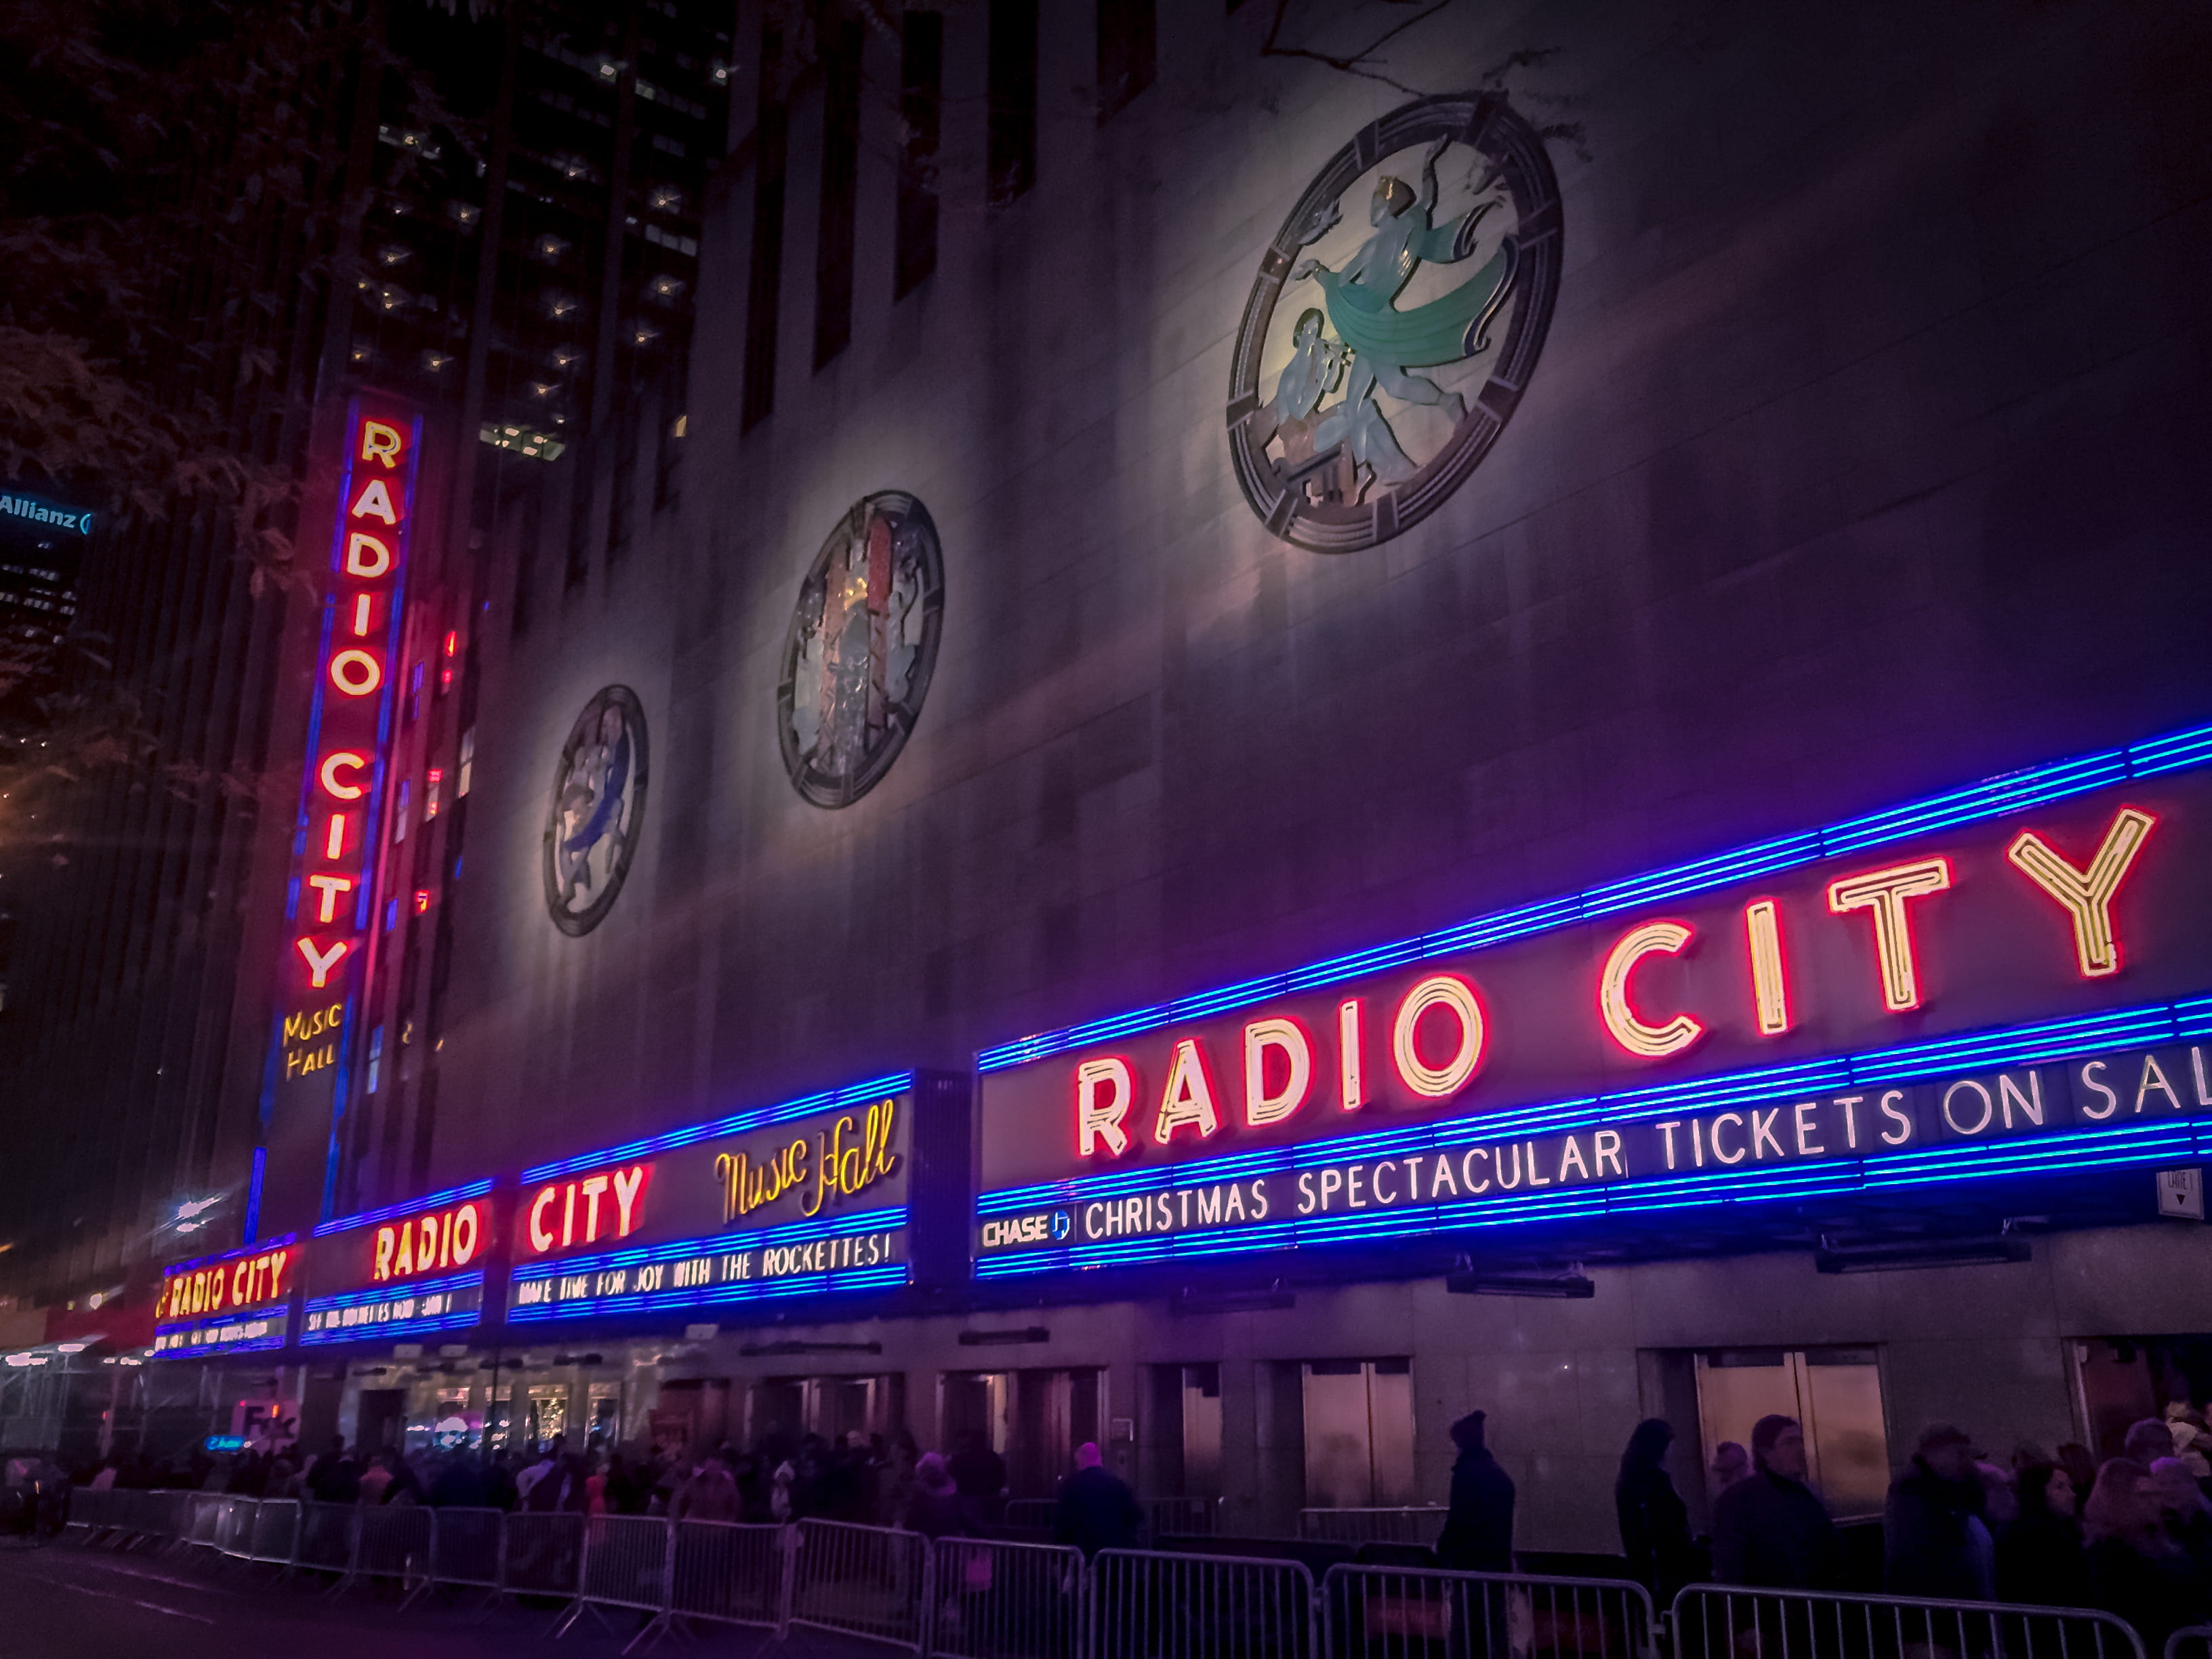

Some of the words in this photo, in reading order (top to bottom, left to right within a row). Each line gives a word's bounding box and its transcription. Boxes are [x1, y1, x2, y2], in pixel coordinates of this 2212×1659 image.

[0, 495, 77, 529] Allianz
[330, 420, 402, 696] RADIO
[296, 752, 365, 988] CITY
[1078, 976, 1483, 1156] RADIO
[1599, 808, 2154, 1057] CITY
[1086, 1179, 1268, 1240] CHRISTMAS
[1298, 1130, 1622, 1214] SPECTACULAR
[1656, 1090, 1912, 1170] TICKETS
[1943, 1070, 2044, 1135] ON
[374, 1204, 478, 1280] RADIO
[530, 1166, 643, 1252] CITY
[982, 1215, 1048, 1247] CHASE
[170, 1268, 225, 1317] RADIO
[232, 1251, 287, 1306] CITY
[596, 1269, 626, 1296] FOR
[633, 1264, 664, 1292] JOY
[674, 1257, 711, 1287] WITH
[721, 1252, 752, 1282] THE
[762, 1233, 890, 1275] ROCKETTES!
